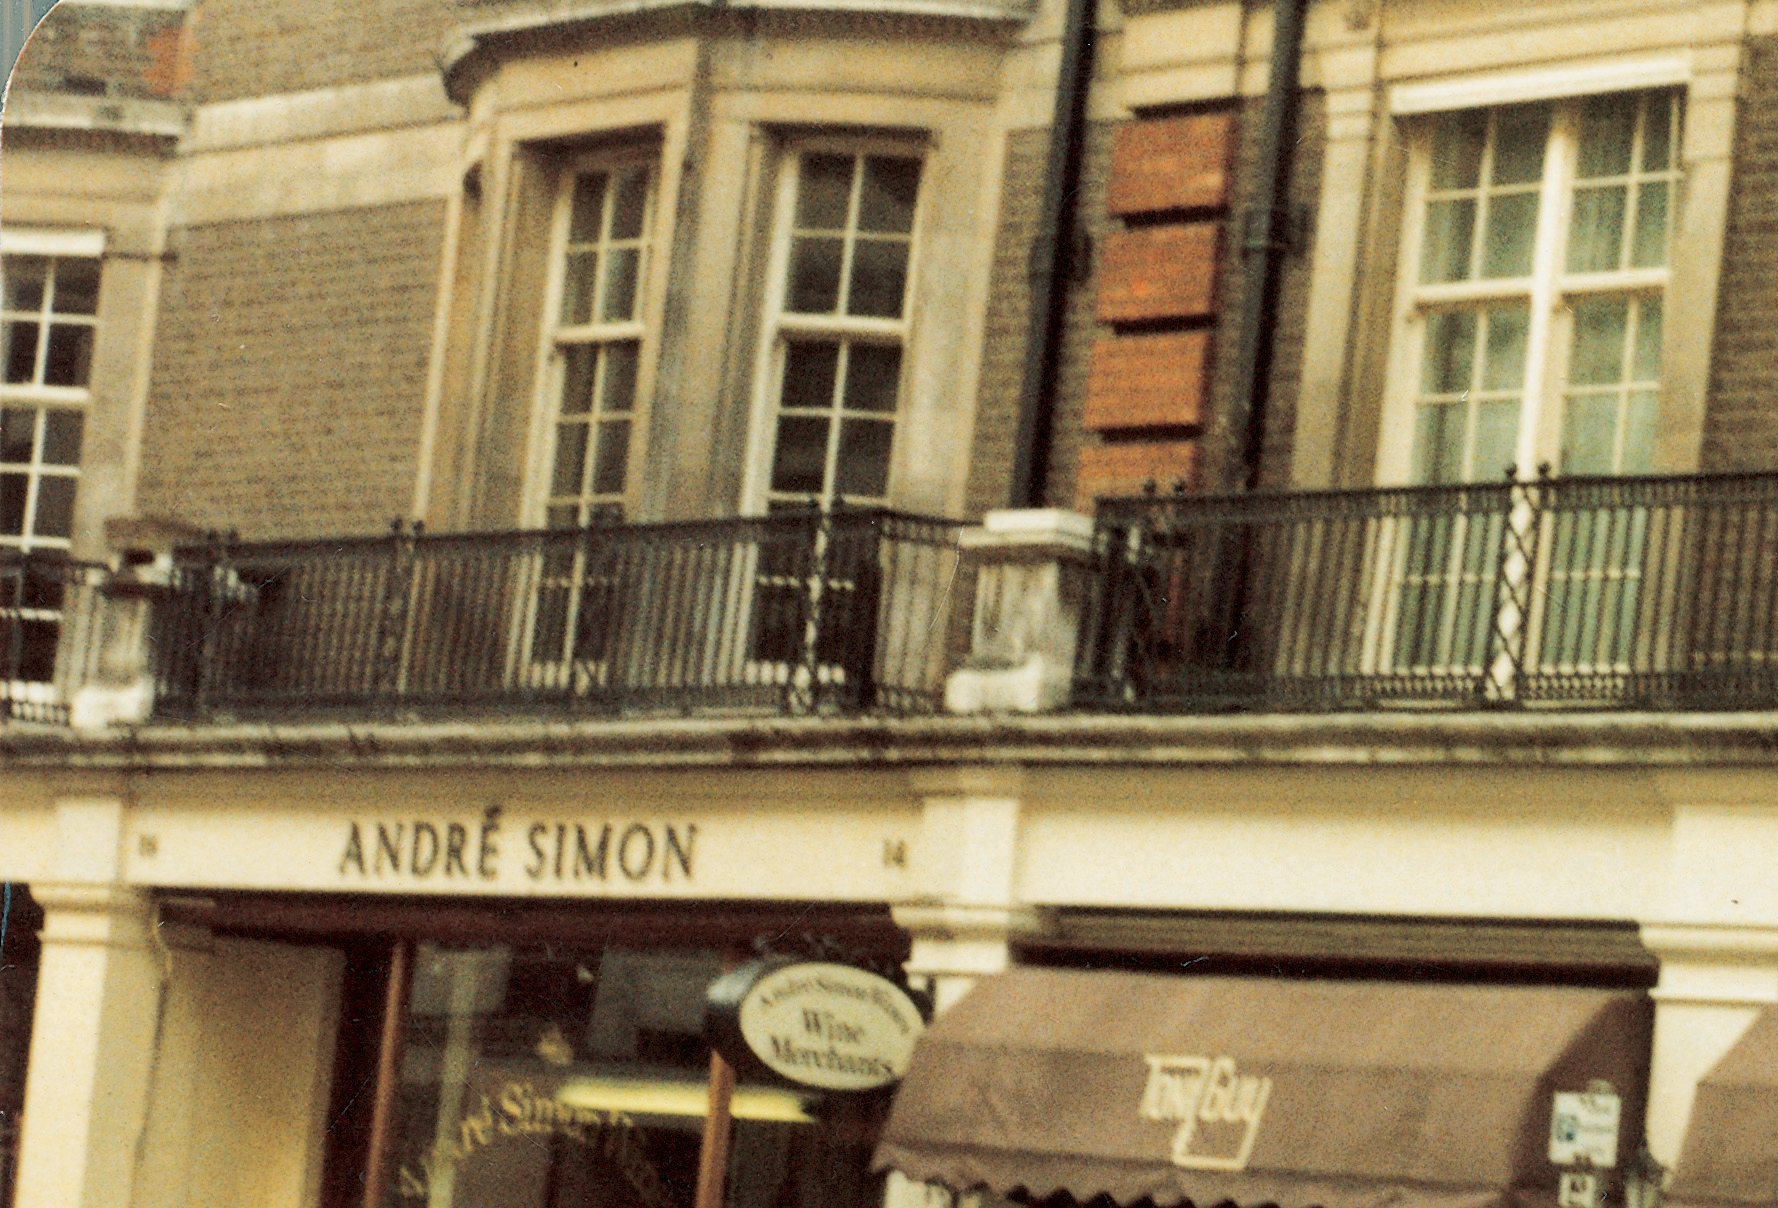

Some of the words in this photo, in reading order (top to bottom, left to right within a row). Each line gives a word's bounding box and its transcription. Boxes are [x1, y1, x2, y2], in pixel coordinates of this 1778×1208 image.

[340, 804, 501, 881] ANDRÉ
[524, 821, 698, 881] SIMON
[802, 1007, 867, 1046] Wine
[769, 1034, 895, 1079] Merchants
